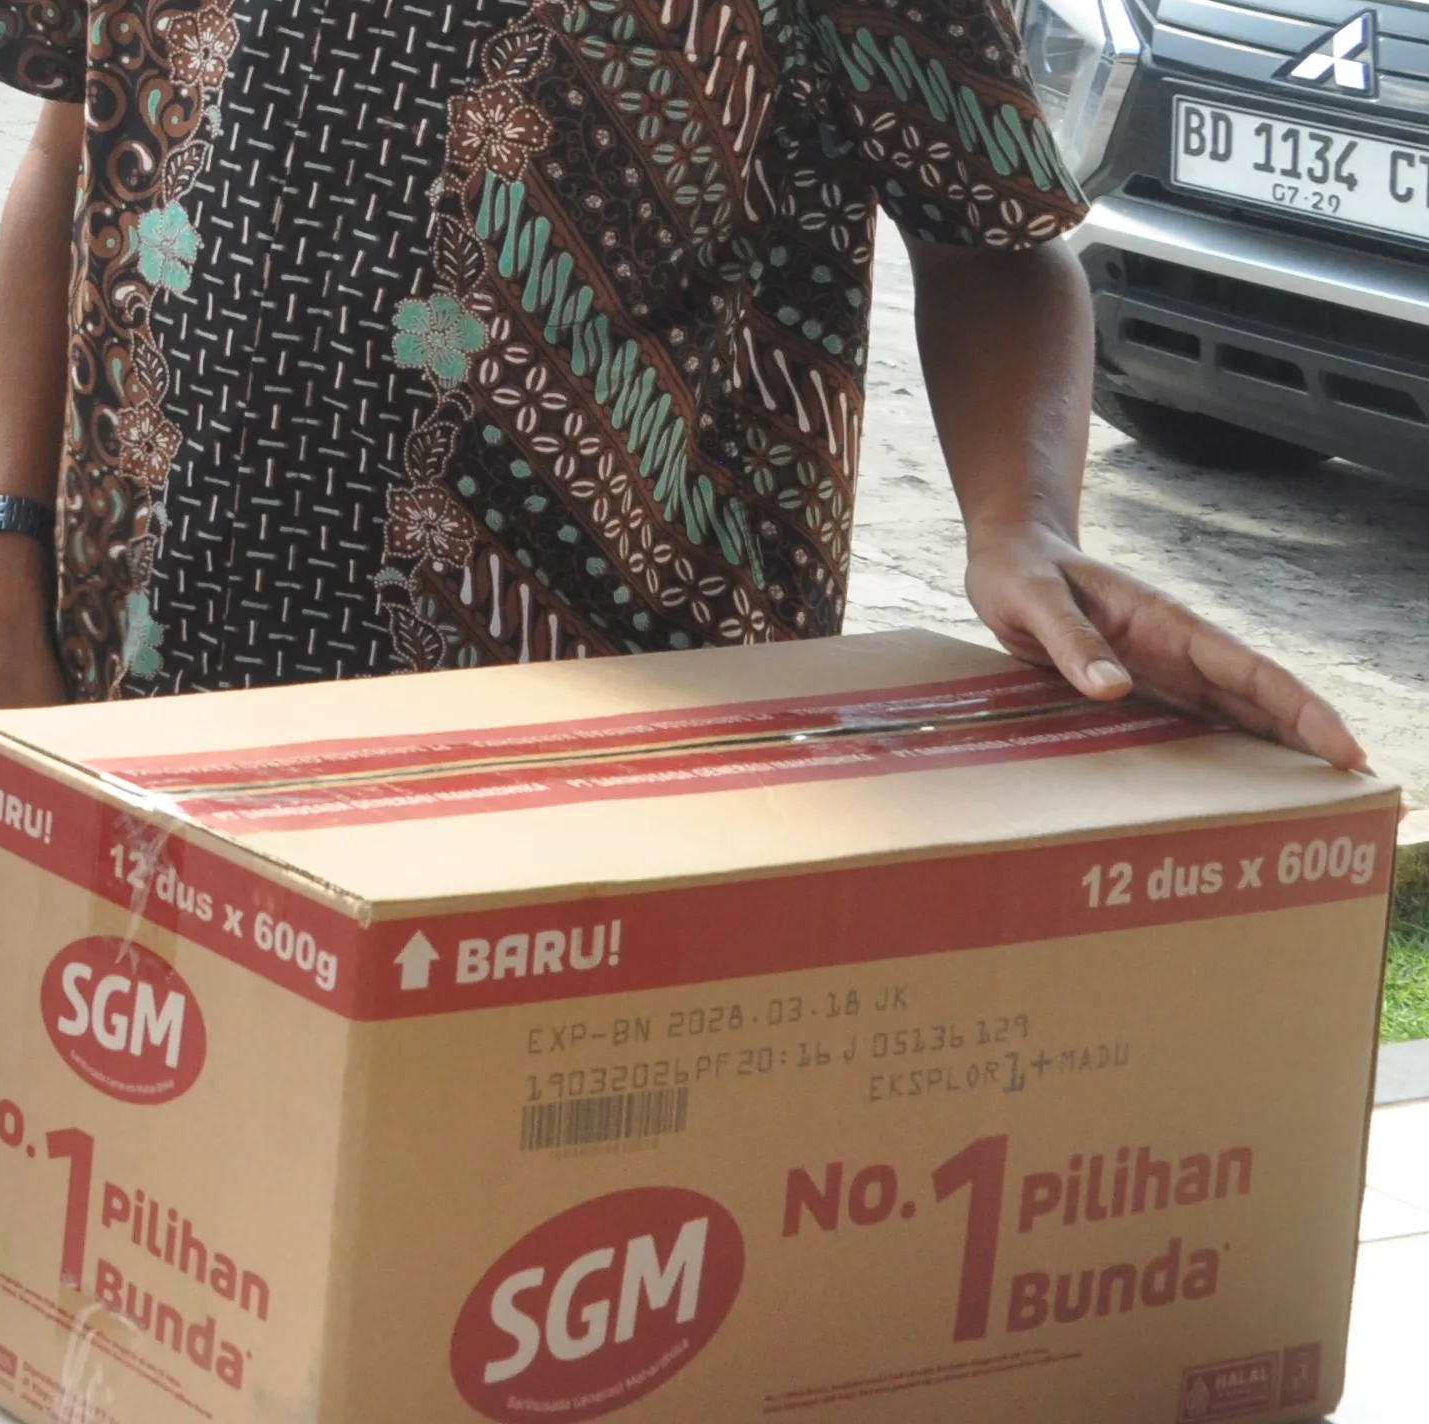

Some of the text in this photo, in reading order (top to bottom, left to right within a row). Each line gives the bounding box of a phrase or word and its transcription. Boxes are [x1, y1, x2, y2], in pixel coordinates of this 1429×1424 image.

[1182, 105, 1233, 162] BD
[1253, 122, 1358, 192] 1134
[109, 843, 338, 992] 12 dus x 600g
[1081, 836, 1377, 908] 12 dus x 600g
[455, 919, 622, 984] BARU!
[57, 961, 186, 1069] SGM
[527, 1016, 651, 1055] EXP-BN
[875, 984, 908, 1012] JK
[45, 1127, 95, 1293] 1
[100, 1180, 270, 1323] Pilihan
[781, 1133, 1254, 1344] No. 1 Pilihan
[484, 1216, 709, 1385] SGM
